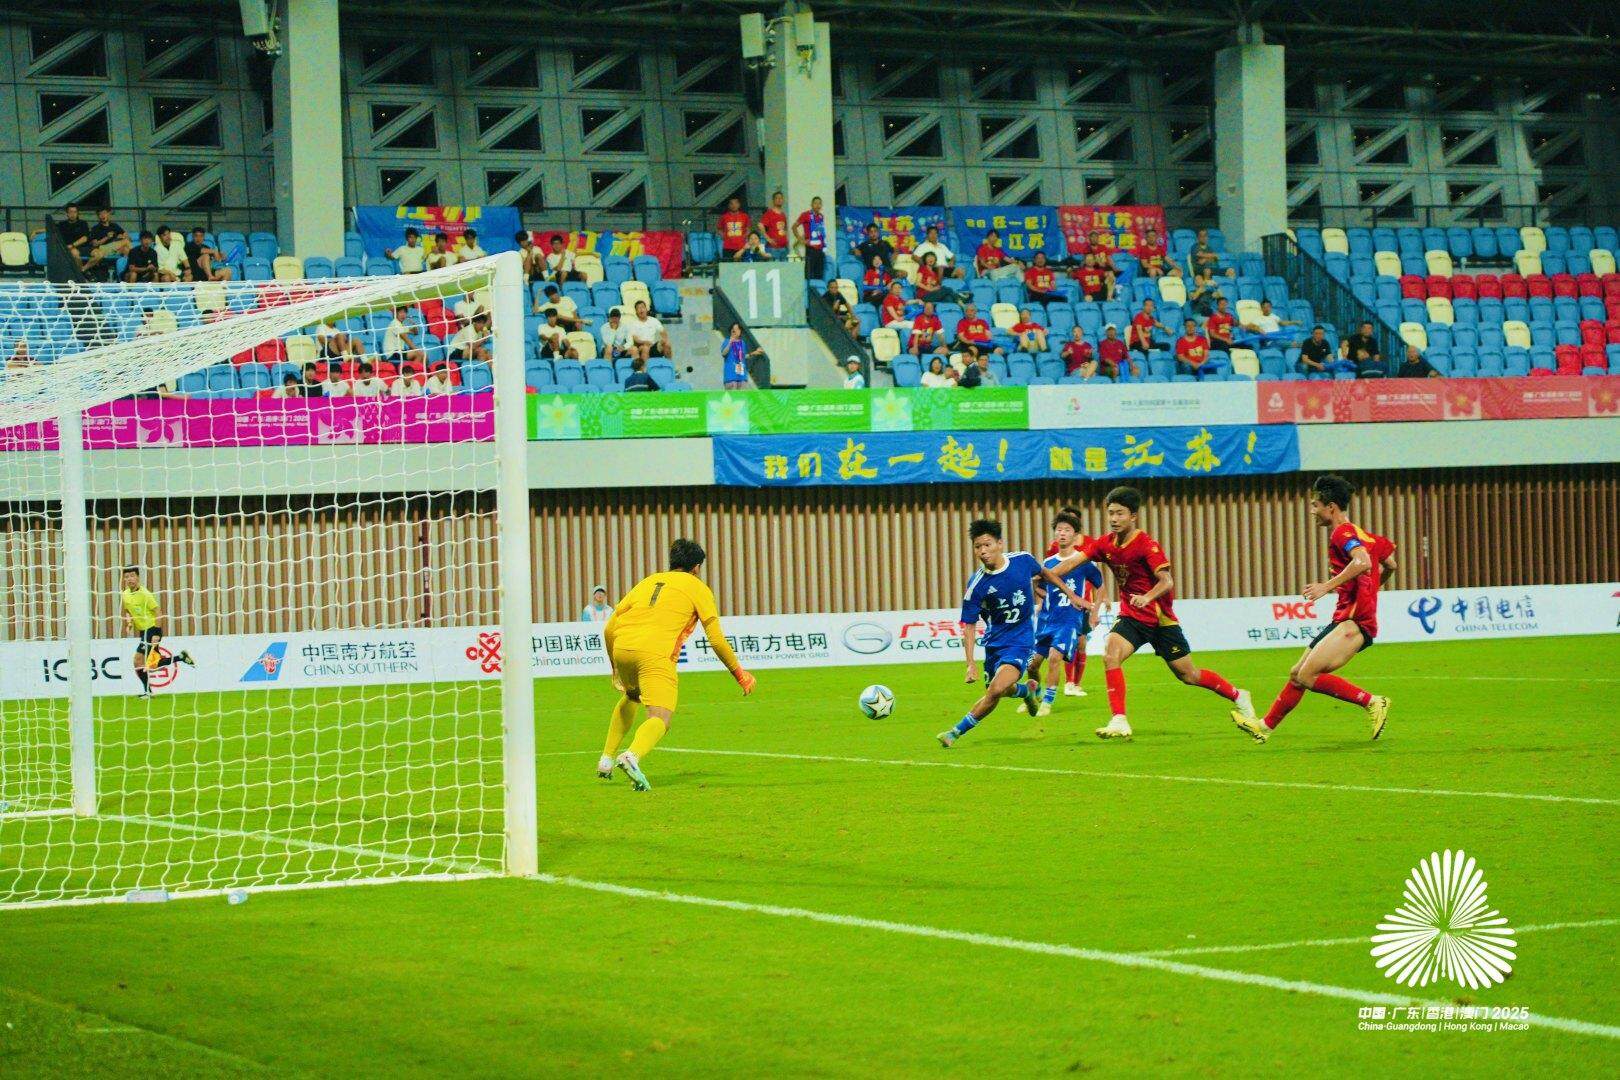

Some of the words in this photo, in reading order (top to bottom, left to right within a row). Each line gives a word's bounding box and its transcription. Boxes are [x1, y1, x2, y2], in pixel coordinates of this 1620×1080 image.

[742, 268, 782, 319] 11
[649, 582, 666, 608] 1
[998, 589, 1027, 609] 上海
[1003, 608, 1020, 624] 22
[1272, 602, 1317, 621] PICC
[1452, 594, 1536, 622] 中国电信
[1247, 625, 1327, 641] 中国人民
[1455, 624, 1488, 633] CHINA
[1491, 621, 1539, 632] TELECOM
[302, 641, 416, 662] 中国南方航空
[531, 634, 603, 653] 中国联通
[900, 638, 943, 650] GAC
[563, 654, 605, 667] unicom
[738, 655, 774, 663] UTHERN
[776, 653, 806, 661] POWER
[808, 651, 830, 659] GRID
[303, 663, 344, 677] CHINA
[348, 660, 419, 676] SOUTHERN
